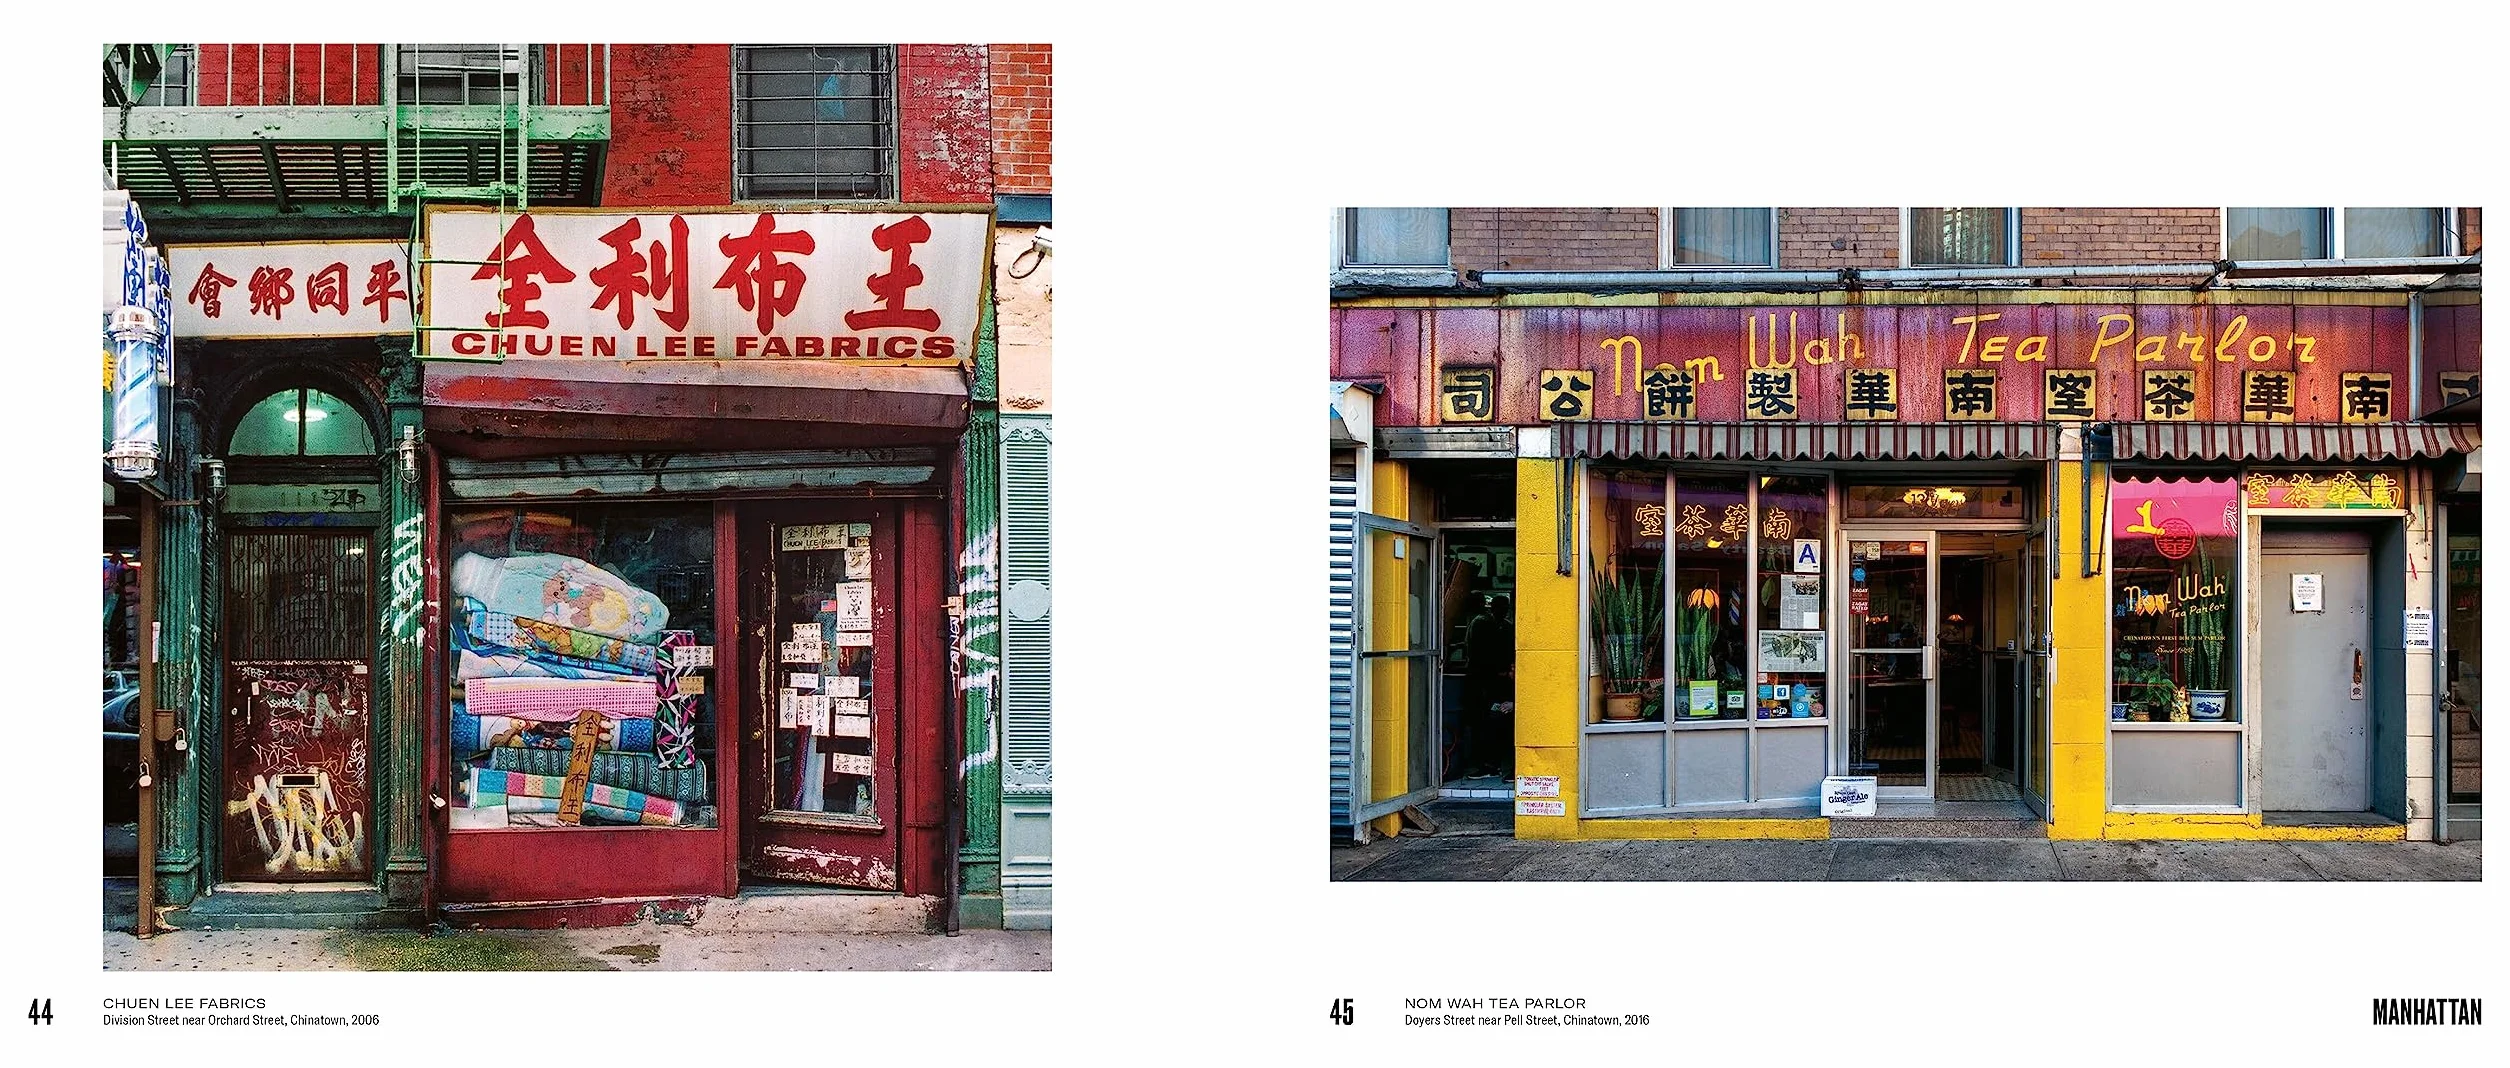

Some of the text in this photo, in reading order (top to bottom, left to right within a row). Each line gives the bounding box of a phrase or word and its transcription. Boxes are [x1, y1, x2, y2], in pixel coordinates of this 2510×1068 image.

[472, 212, 941, 334] 全利布王
[452, 333, 957, 358] CHUEN LEE FABRICS
[1600, 311, 1865, 396] Nm Wah
[1951, 312, 2317, 364] Tea Parlor
[1798, 543, 1817, 564] A
[2177, 574, 2225, 602] Wah
[2169, 603, 2226, 618] Tea Parlor
[563, 714, 599, 817] 全利布王
